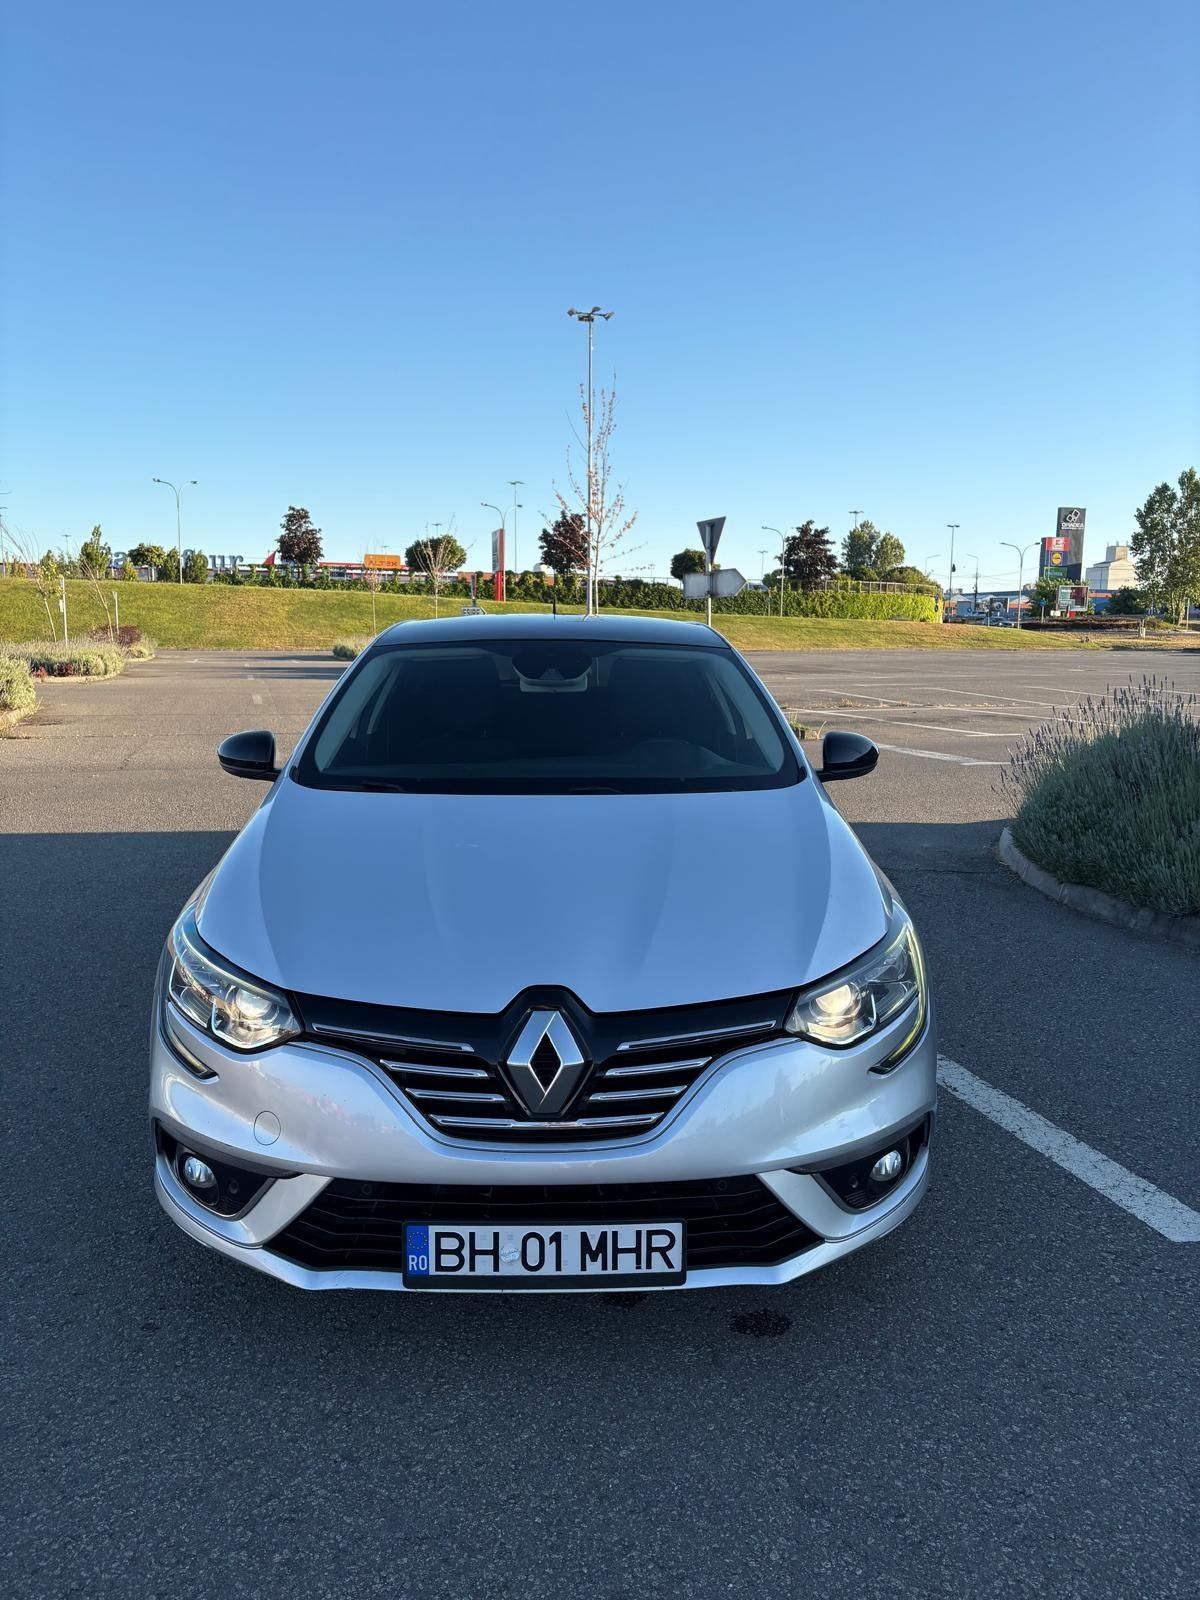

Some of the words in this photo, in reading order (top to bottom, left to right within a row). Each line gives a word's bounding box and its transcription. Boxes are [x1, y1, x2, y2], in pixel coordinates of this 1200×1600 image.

[408, 1255, 427, 1271] RO
[434, 1231, 500, 1272] BH
[521, 1231, 562, 1272] 01
[580, 1229, 676, 1271] MHR
